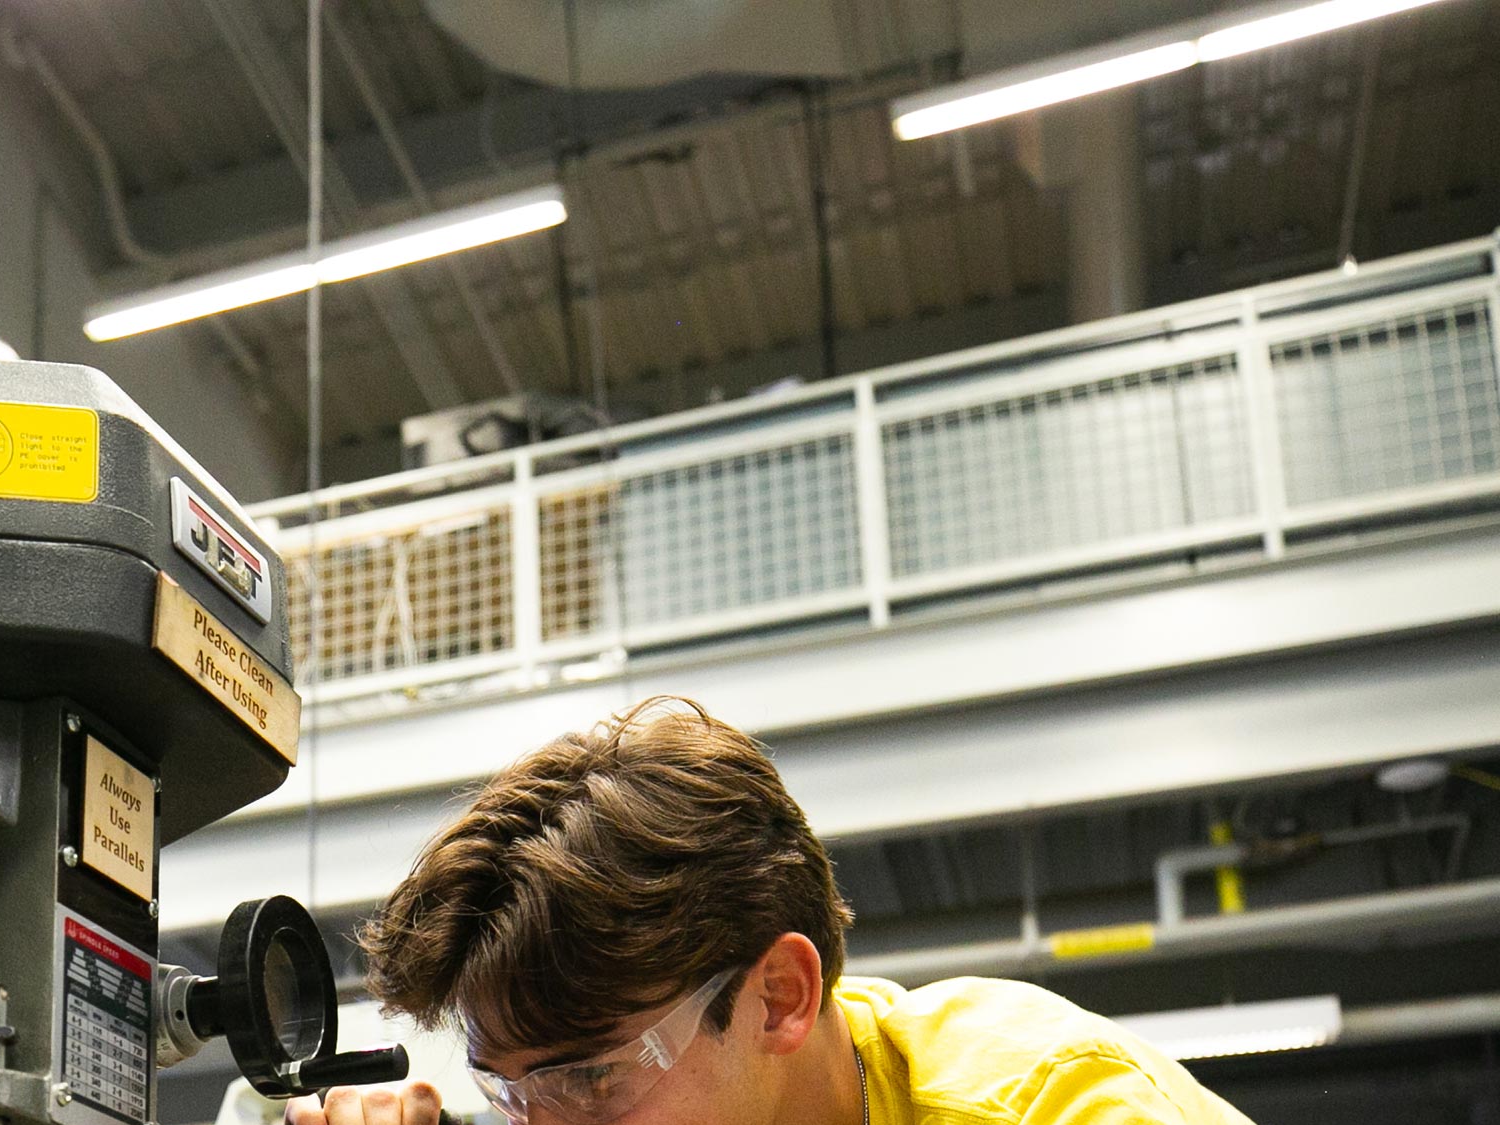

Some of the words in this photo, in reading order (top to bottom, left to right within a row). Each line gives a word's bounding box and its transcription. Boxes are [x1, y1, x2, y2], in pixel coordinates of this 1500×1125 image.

[19, 462, 66, 472] prohibited
[69, 445, 83, 453] the
[193, 608, 236, 663] Please
[239, 651, 274, 697] Clean
[194, 648, 230, 692] After
[232, 678, 268, 730] Using
[99, 773, 142, 812] Always
[109, 805, 131, 834] Use
[93, 824, 145, 873] Parallels
